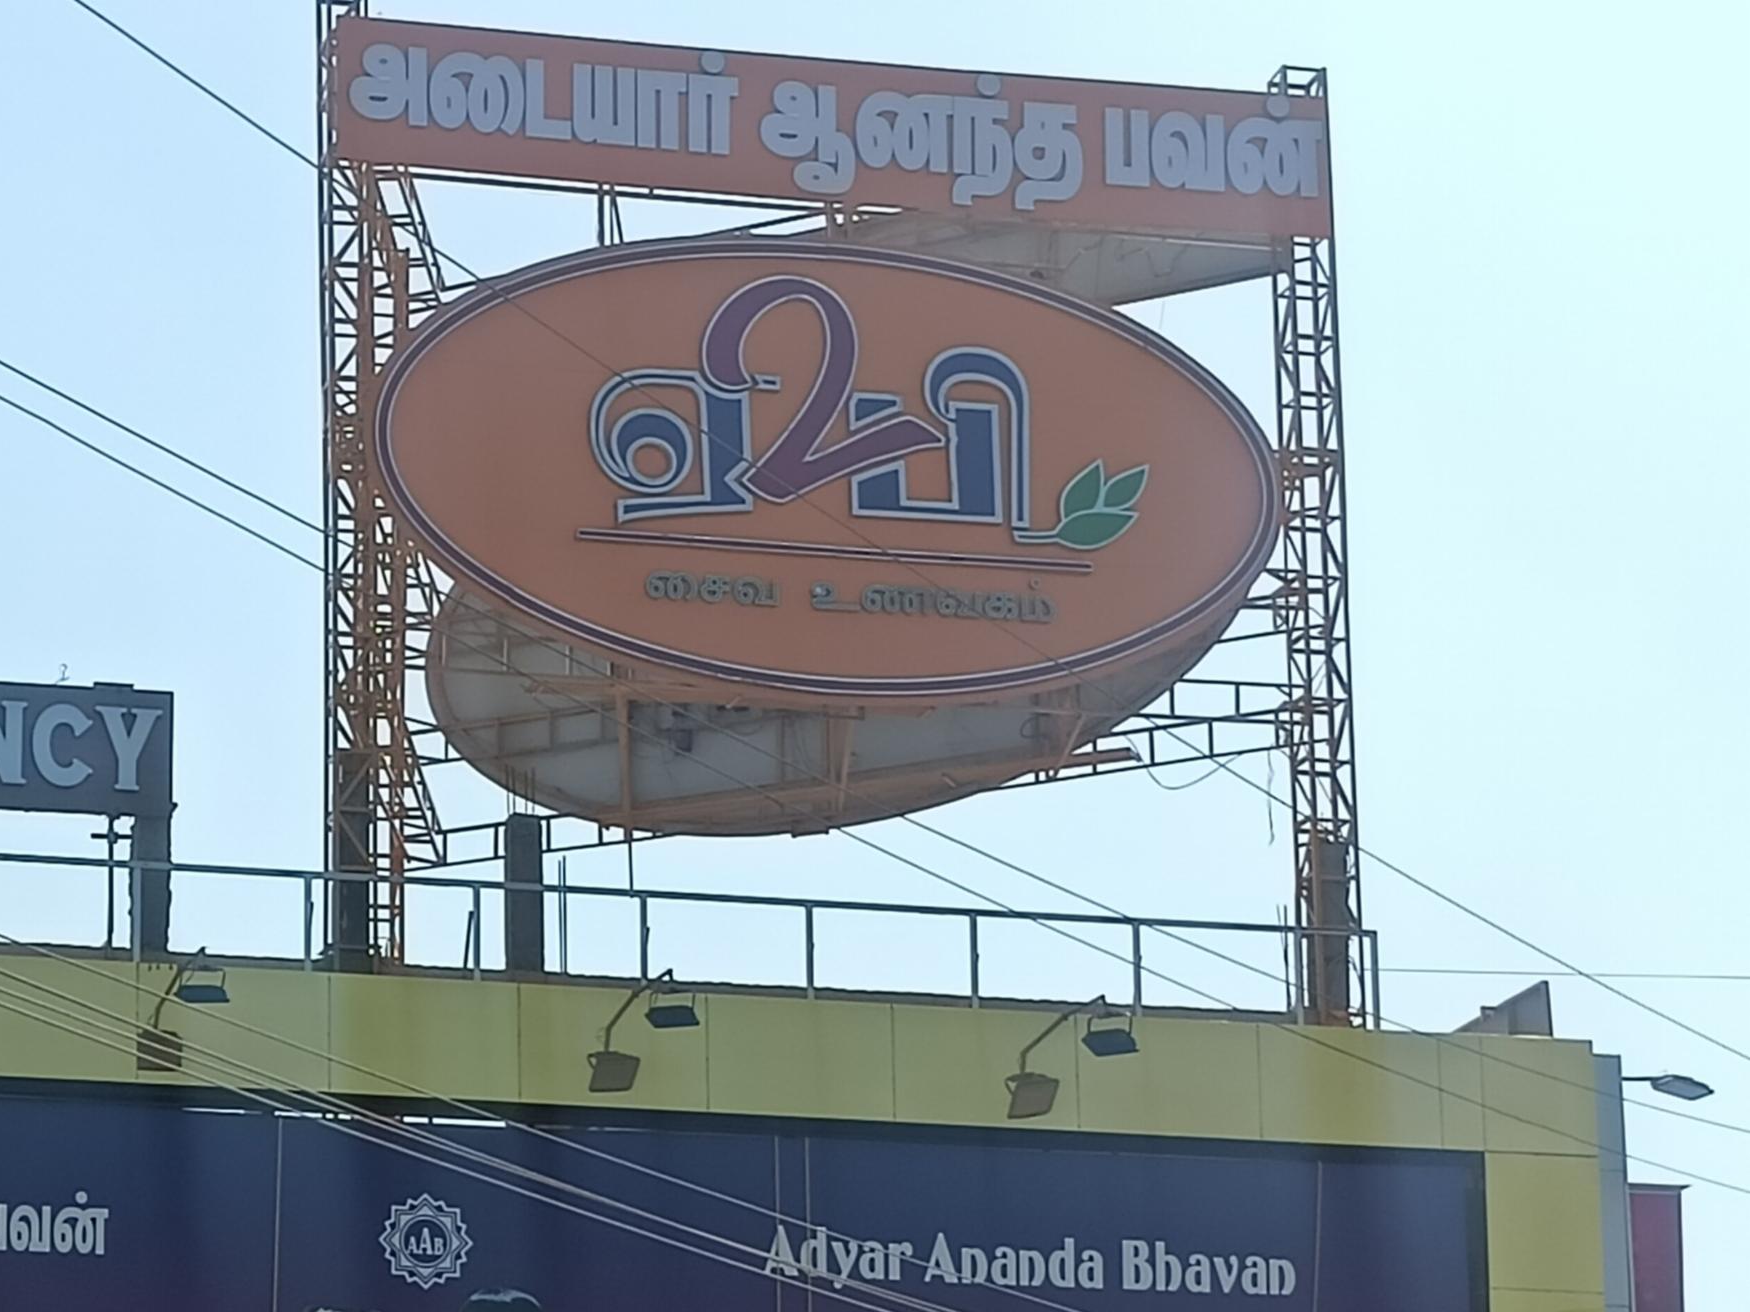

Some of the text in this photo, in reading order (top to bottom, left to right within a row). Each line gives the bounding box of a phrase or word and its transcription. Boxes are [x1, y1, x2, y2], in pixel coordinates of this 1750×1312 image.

[349, 42, 1323, 209] அடையார் ஆனந்த பவன்
[764, 1224, 1296, 1296] Adyar Ananda Bhavan
